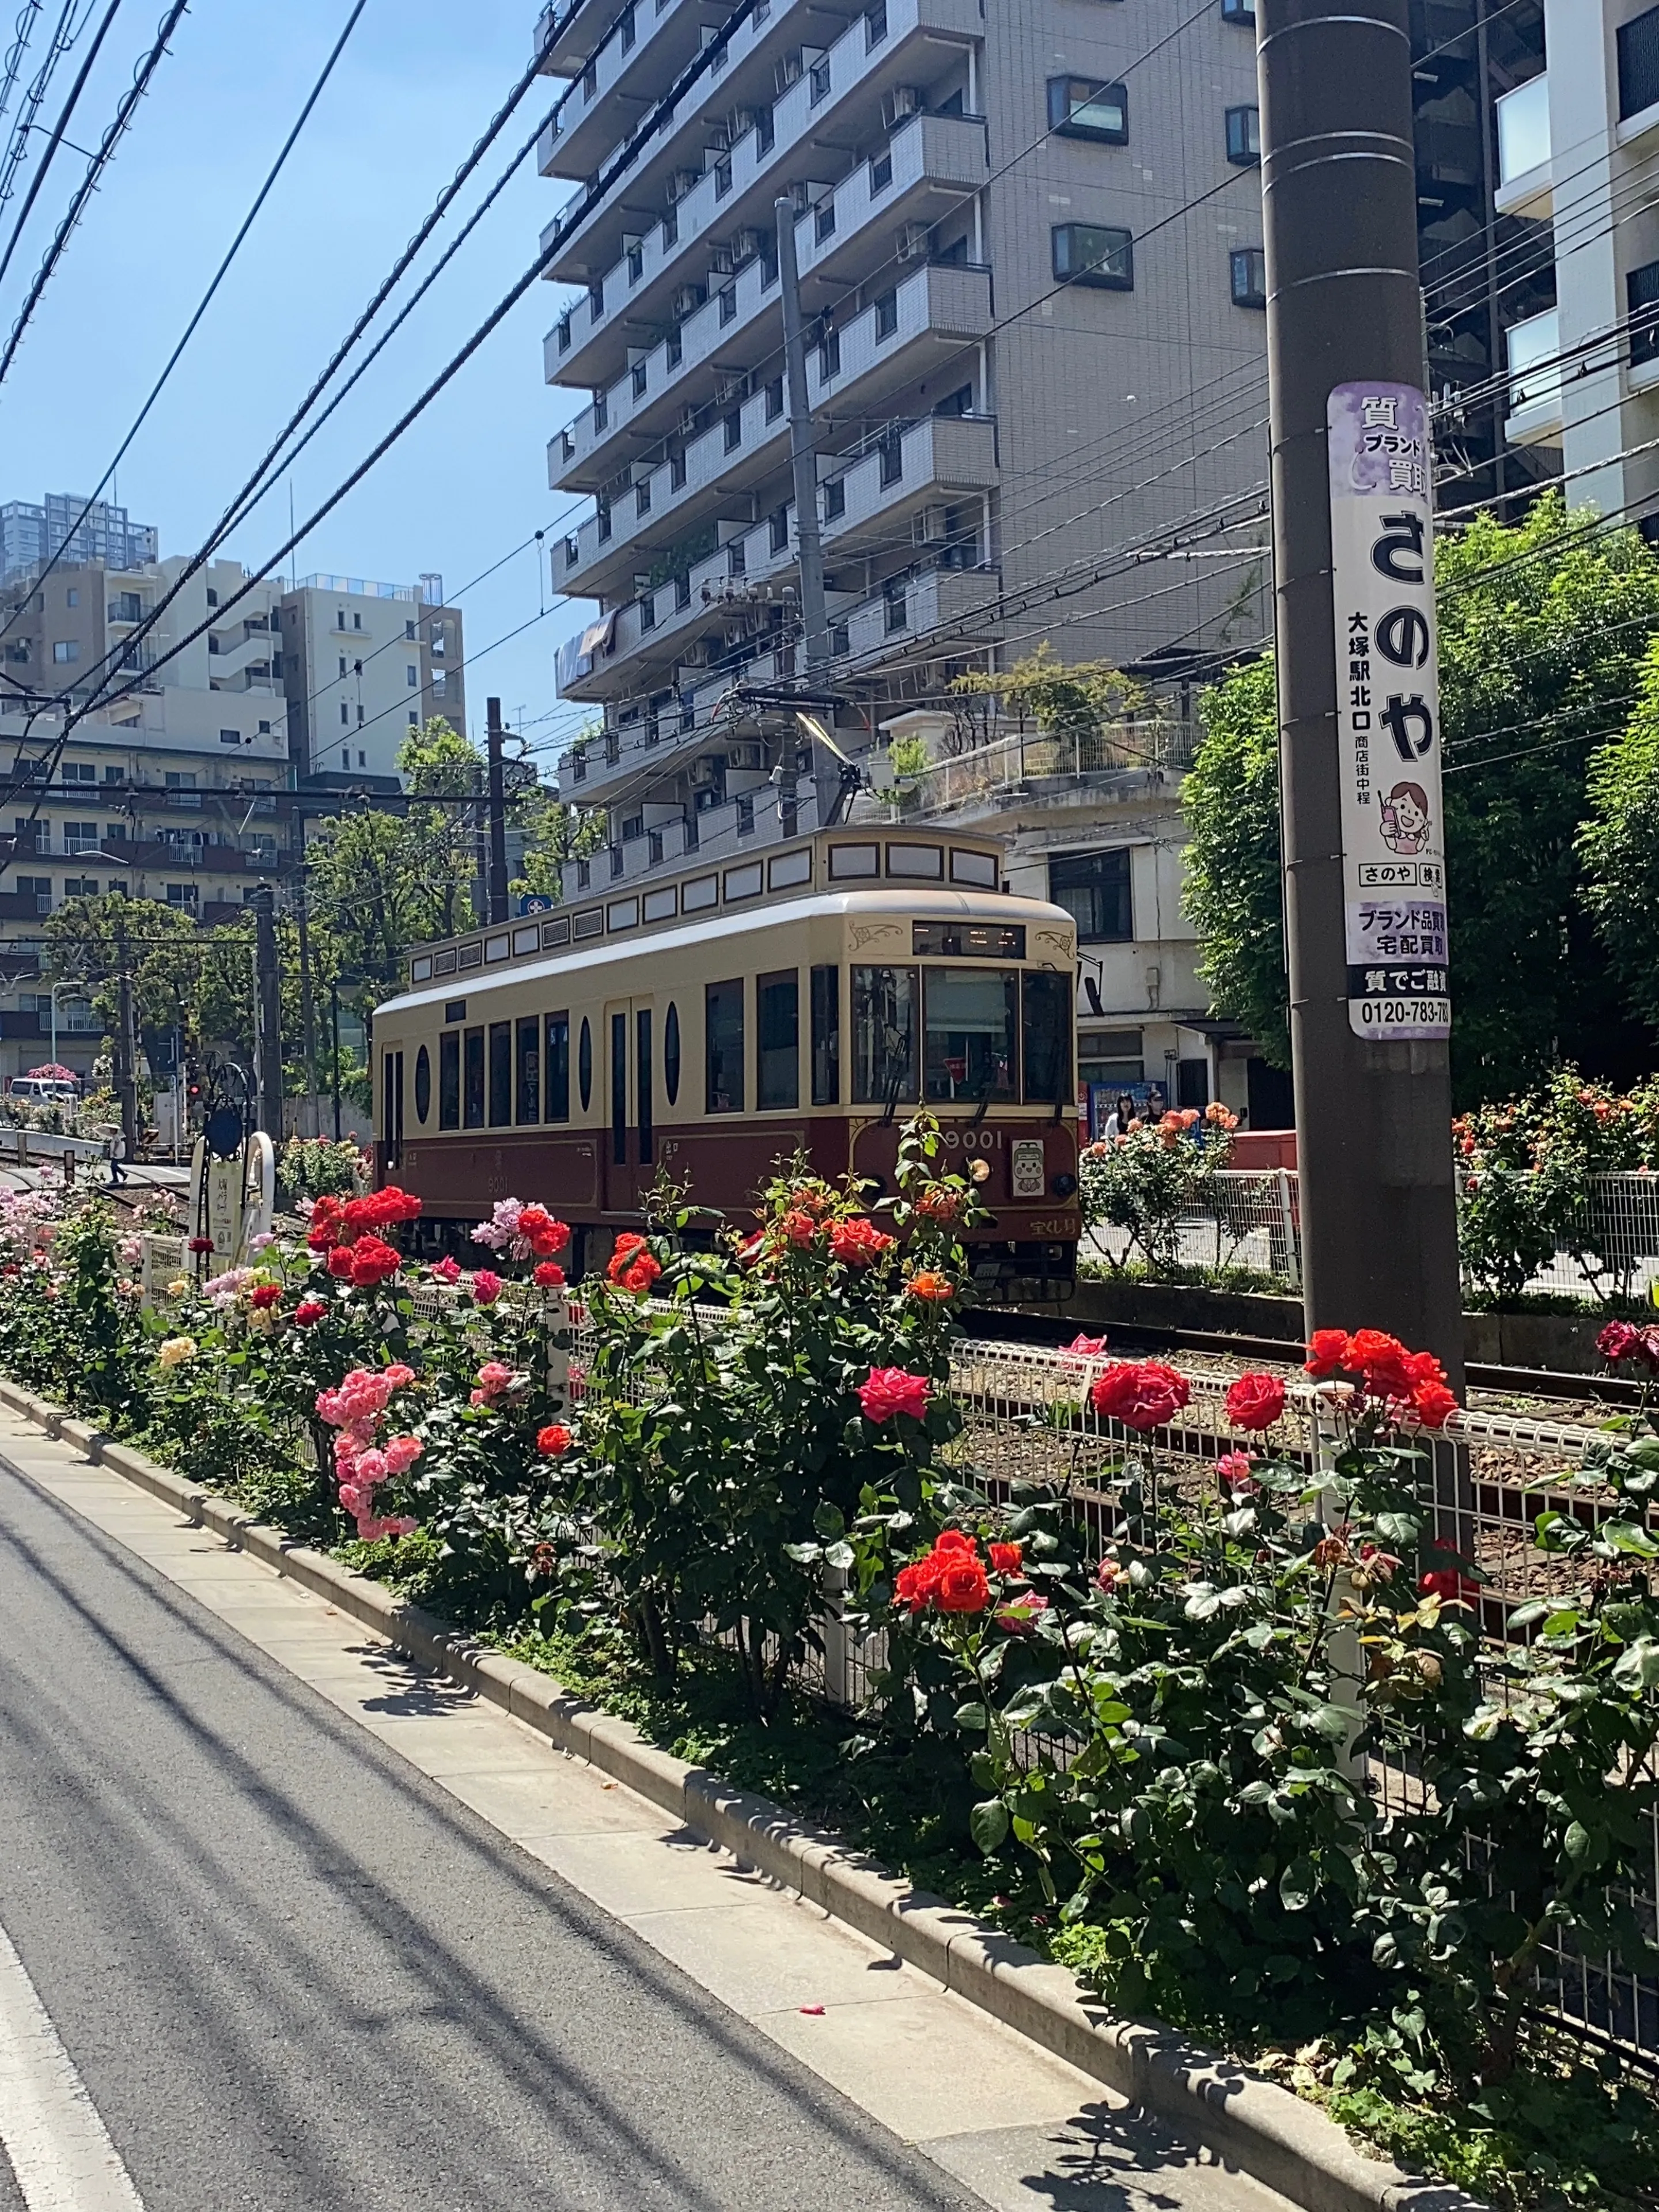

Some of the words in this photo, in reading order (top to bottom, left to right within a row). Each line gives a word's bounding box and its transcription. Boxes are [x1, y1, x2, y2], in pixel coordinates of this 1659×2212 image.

[1361, 396, 1399, 430] 質
[1364, 433, 1421, 457] ブランド
[1370, 510, 1433, 762] さのや
[1365, 866, 1411, 882] さのや
[945, 1130, 1002, 1149] 9001
